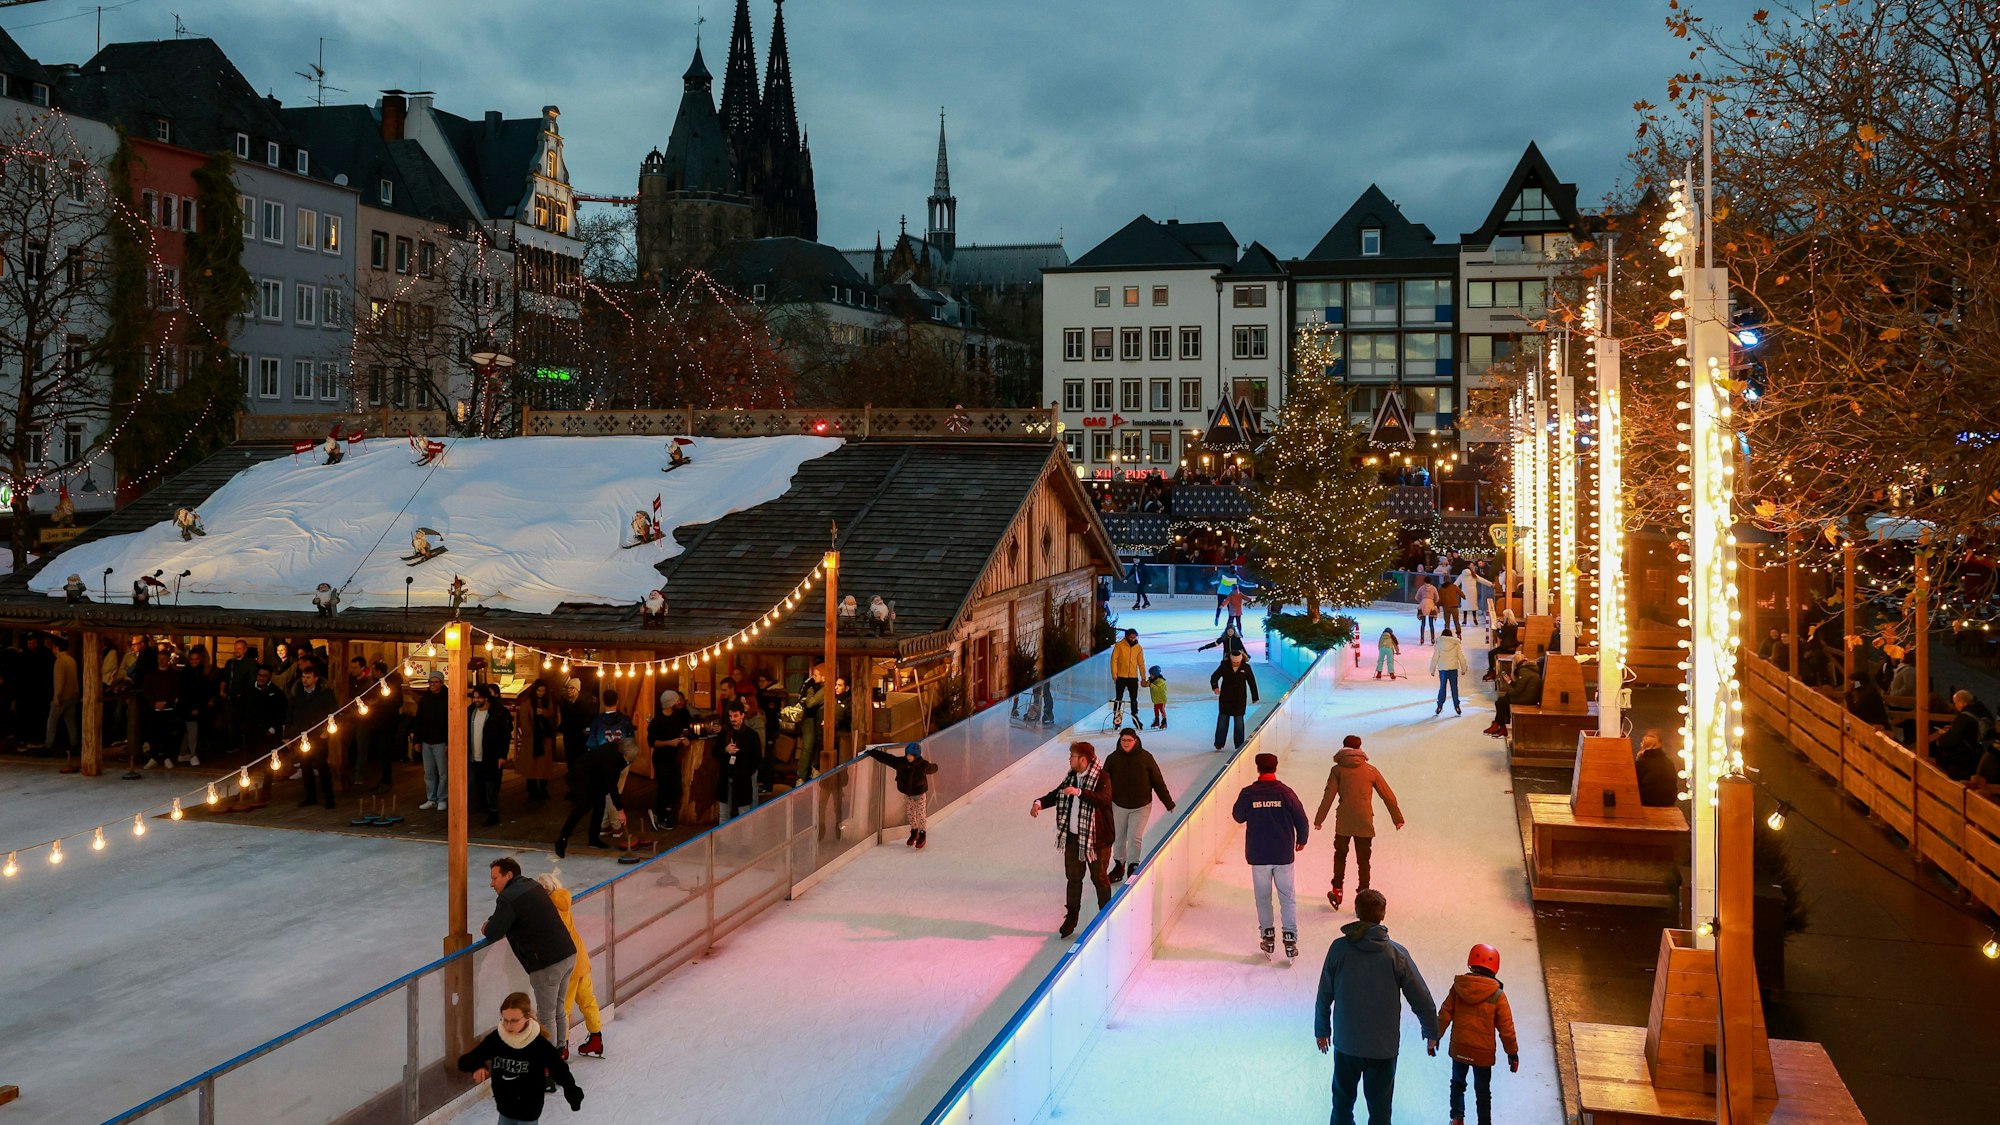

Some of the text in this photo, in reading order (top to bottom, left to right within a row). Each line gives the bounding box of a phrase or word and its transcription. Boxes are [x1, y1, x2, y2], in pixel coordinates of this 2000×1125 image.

[1082, 416, 1184, 427] GAG Immobilien AG
[1252, 800, 1282, 809] EIS LOTSE
[493, 1056, 529, 1074] NIKE
